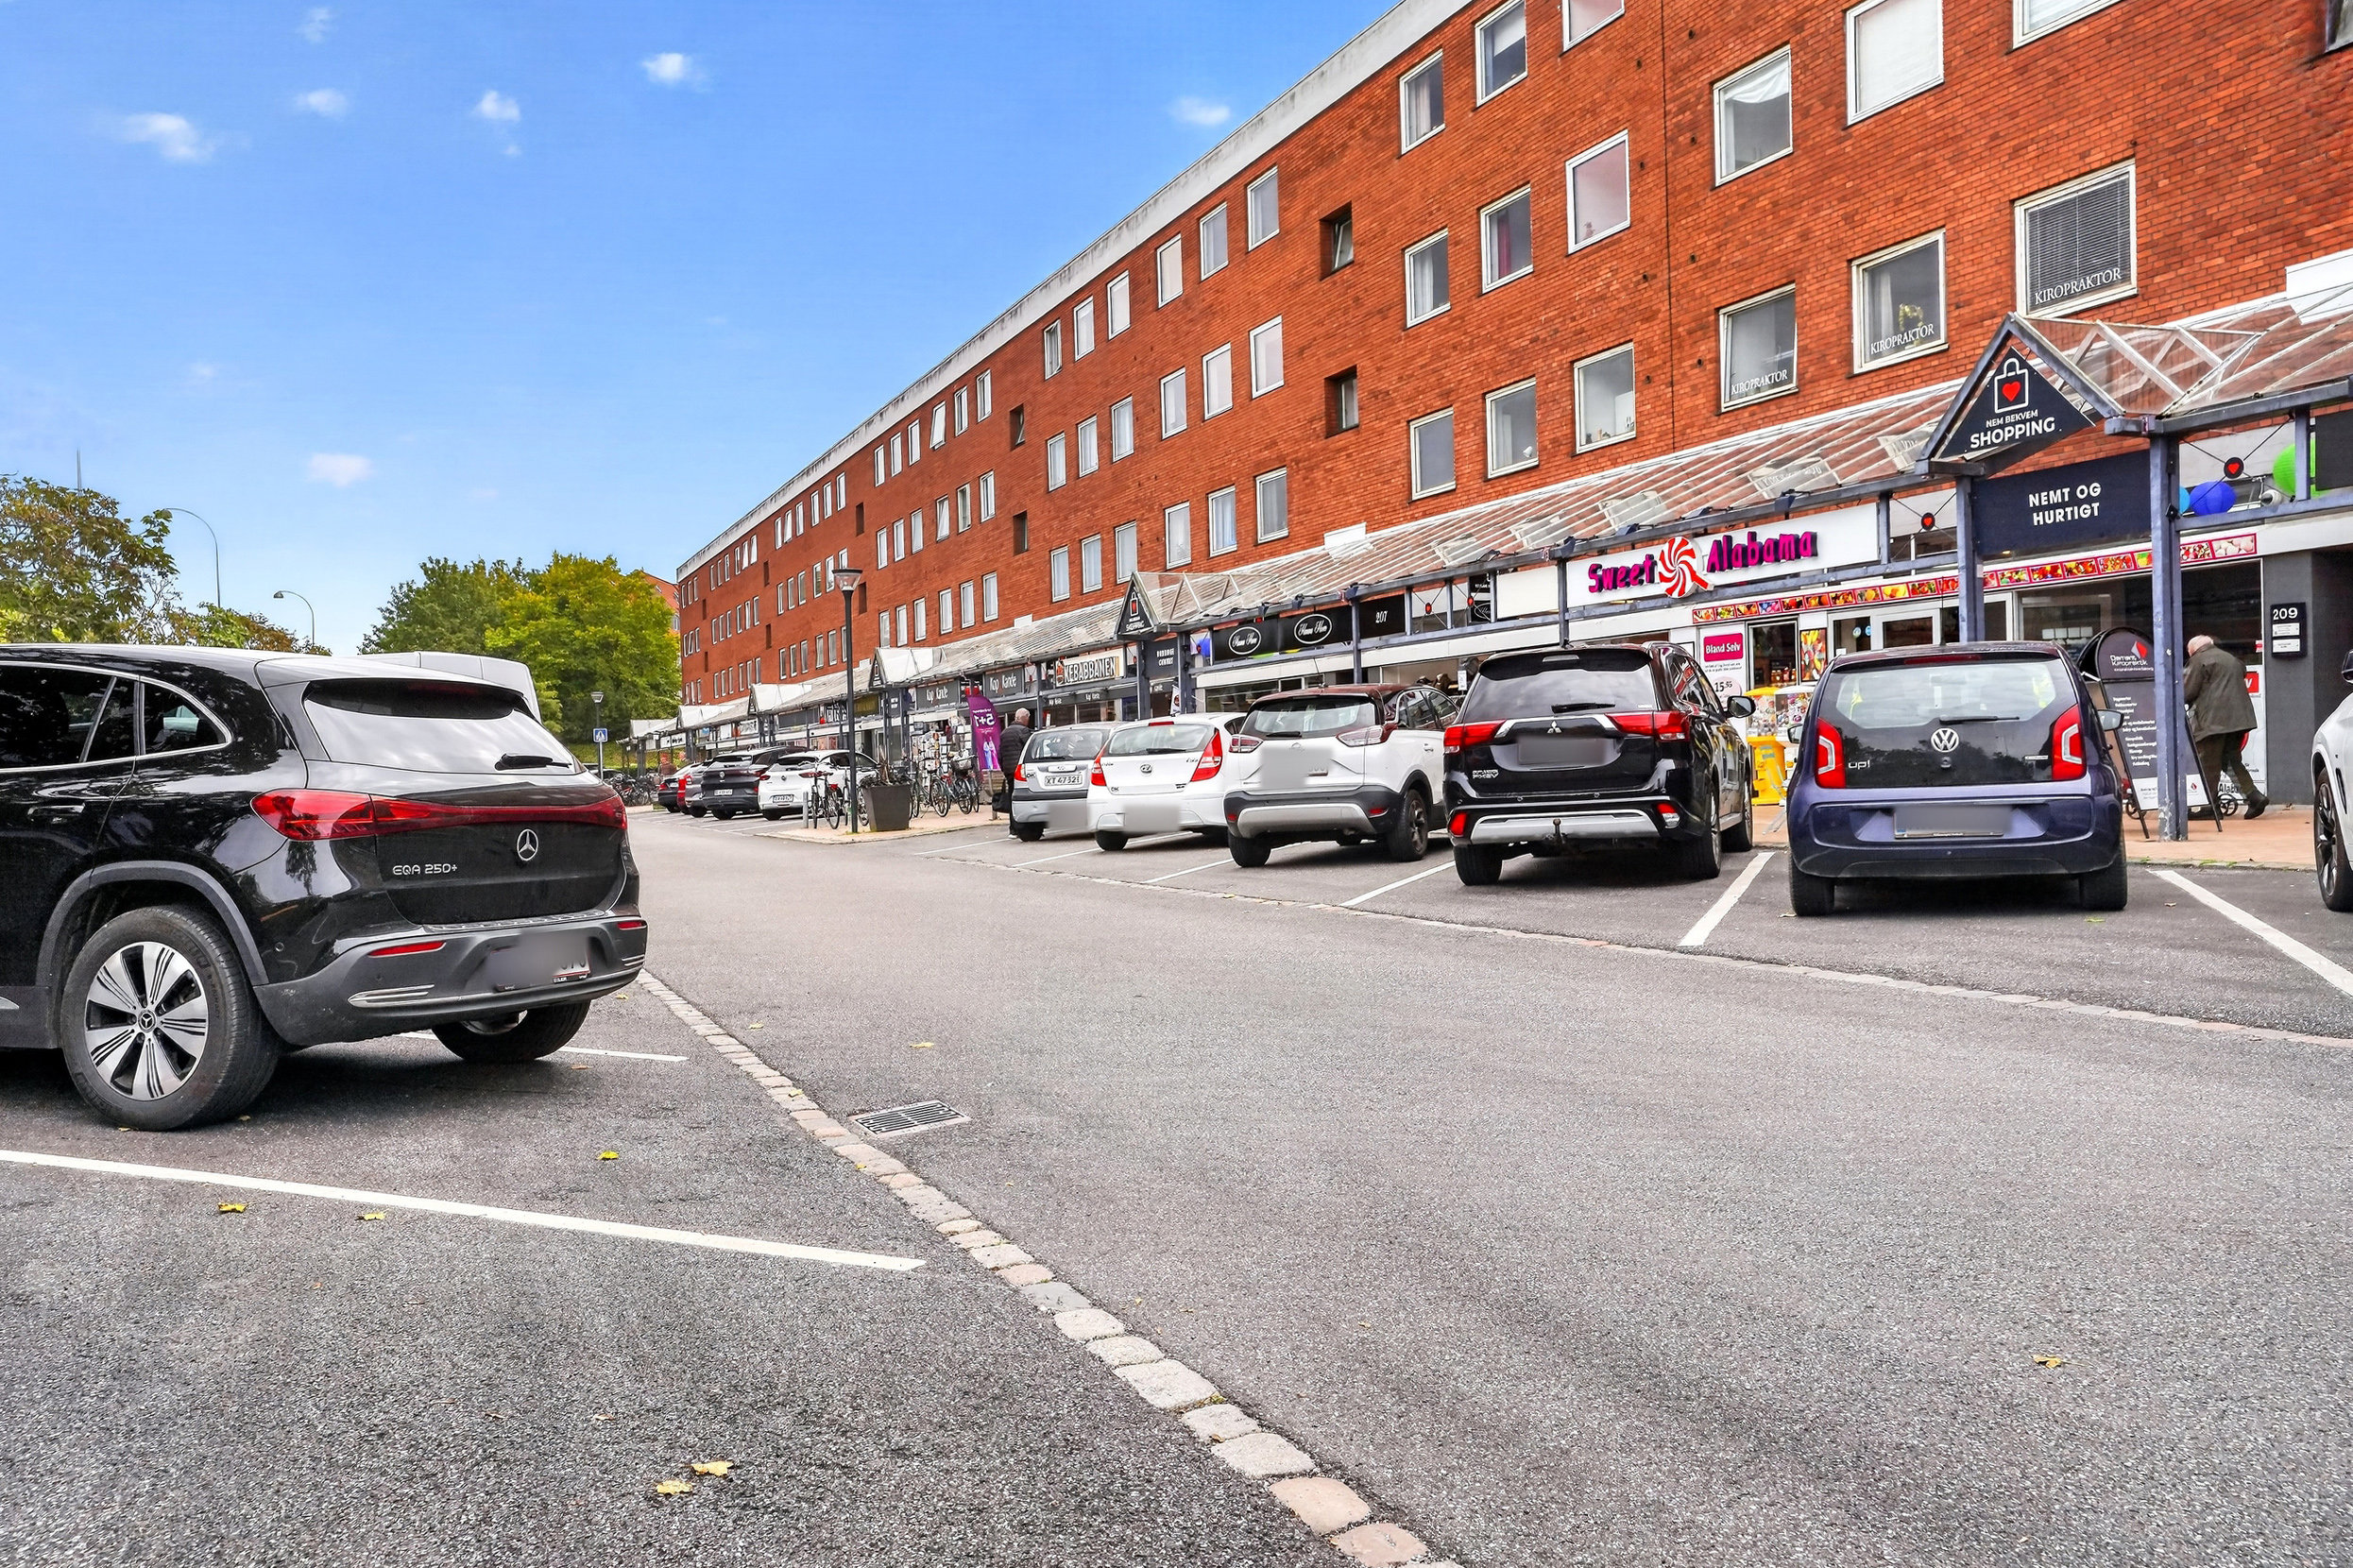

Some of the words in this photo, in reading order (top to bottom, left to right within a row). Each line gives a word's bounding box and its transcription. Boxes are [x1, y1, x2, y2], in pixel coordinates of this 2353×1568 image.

[2034, 266, 2123, 306] KIROPRAKTOR
[1869, 323, 1935, 355] KIROPRAKTOR
[1731, 368, 1788, 396] KIROPRAKTOR
[1986, 416, 2004, 429] NEM
[2004, 409, 2038, 425] BEKVEM
[1969, 417, 2055, 449] SHOPPING
[2028, 487, 2071, 508] NEMT
[2075, 482, 2102, 500] OG
[2032, 502, 2101, 526] HURTIGT
[1588, 554, 1657, 593] Sweet
[1706, 531, 1818, 573] Alabama
[1375, 610, 1389, 623] 207
[2273, 607, 2298, 621] 209
[1705, 642, 1726, 655] Bland
[1726, 641, 1742, 653] Selv
[1064, 656, 1116, 683] KEBABBANEN
[1848, 759, 1871, 770] up!
[392, 864, 421, 876] EQA
[424, 862, 458, 875] 250+
